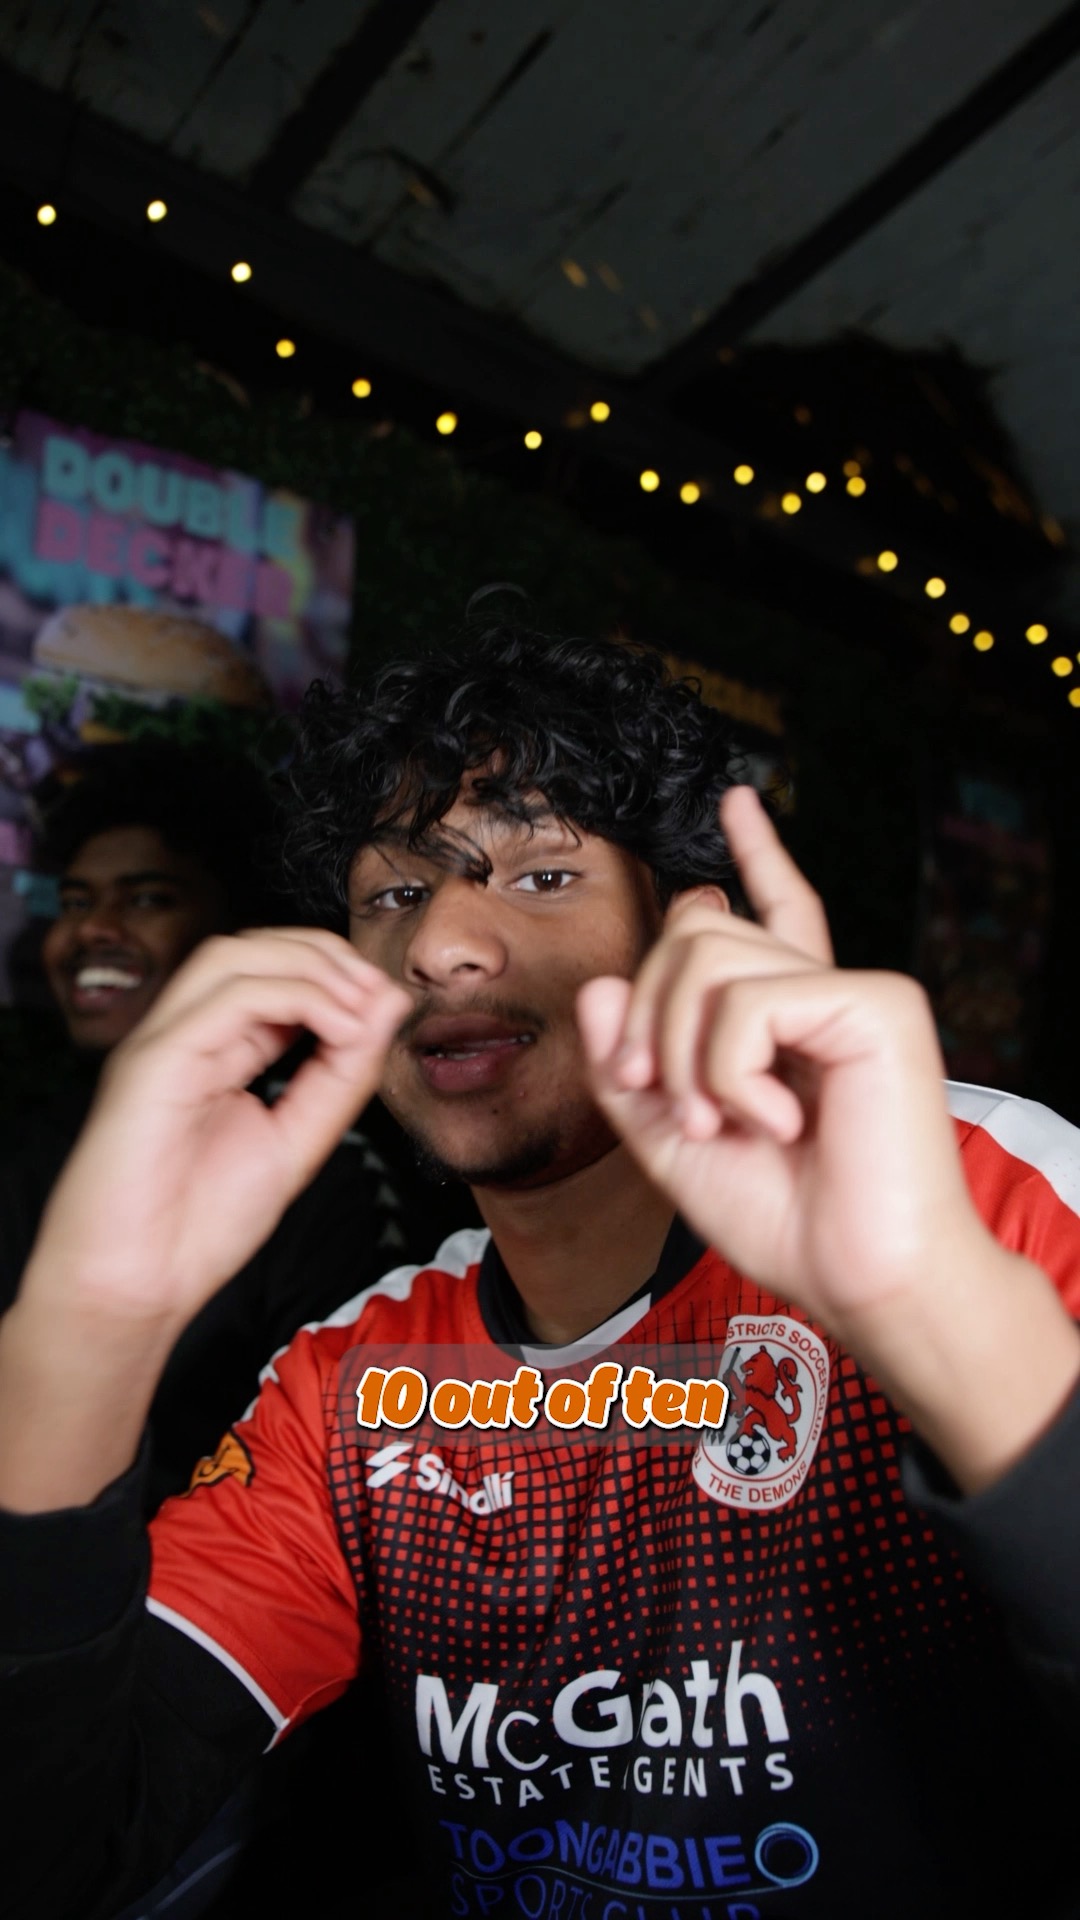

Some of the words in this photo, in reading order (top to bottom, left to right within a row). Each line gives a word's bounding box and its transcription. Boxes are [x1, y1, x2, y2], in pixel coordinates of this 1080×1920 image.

[42, 433, 299, 562] DOUBLE
[788, 1330, 826, 1391] SOCCER
[708, 1472, 743, 1501] THE
[748, 1460, 807, 1503] DEMONS
[414, 1639, 791, 1772] McGath
[427, 1754, 612, 1808] ESTATE
[621, 1751, 795, 1799] GENTS
[438, 1818, 752, 1889] TOONGABBIE
